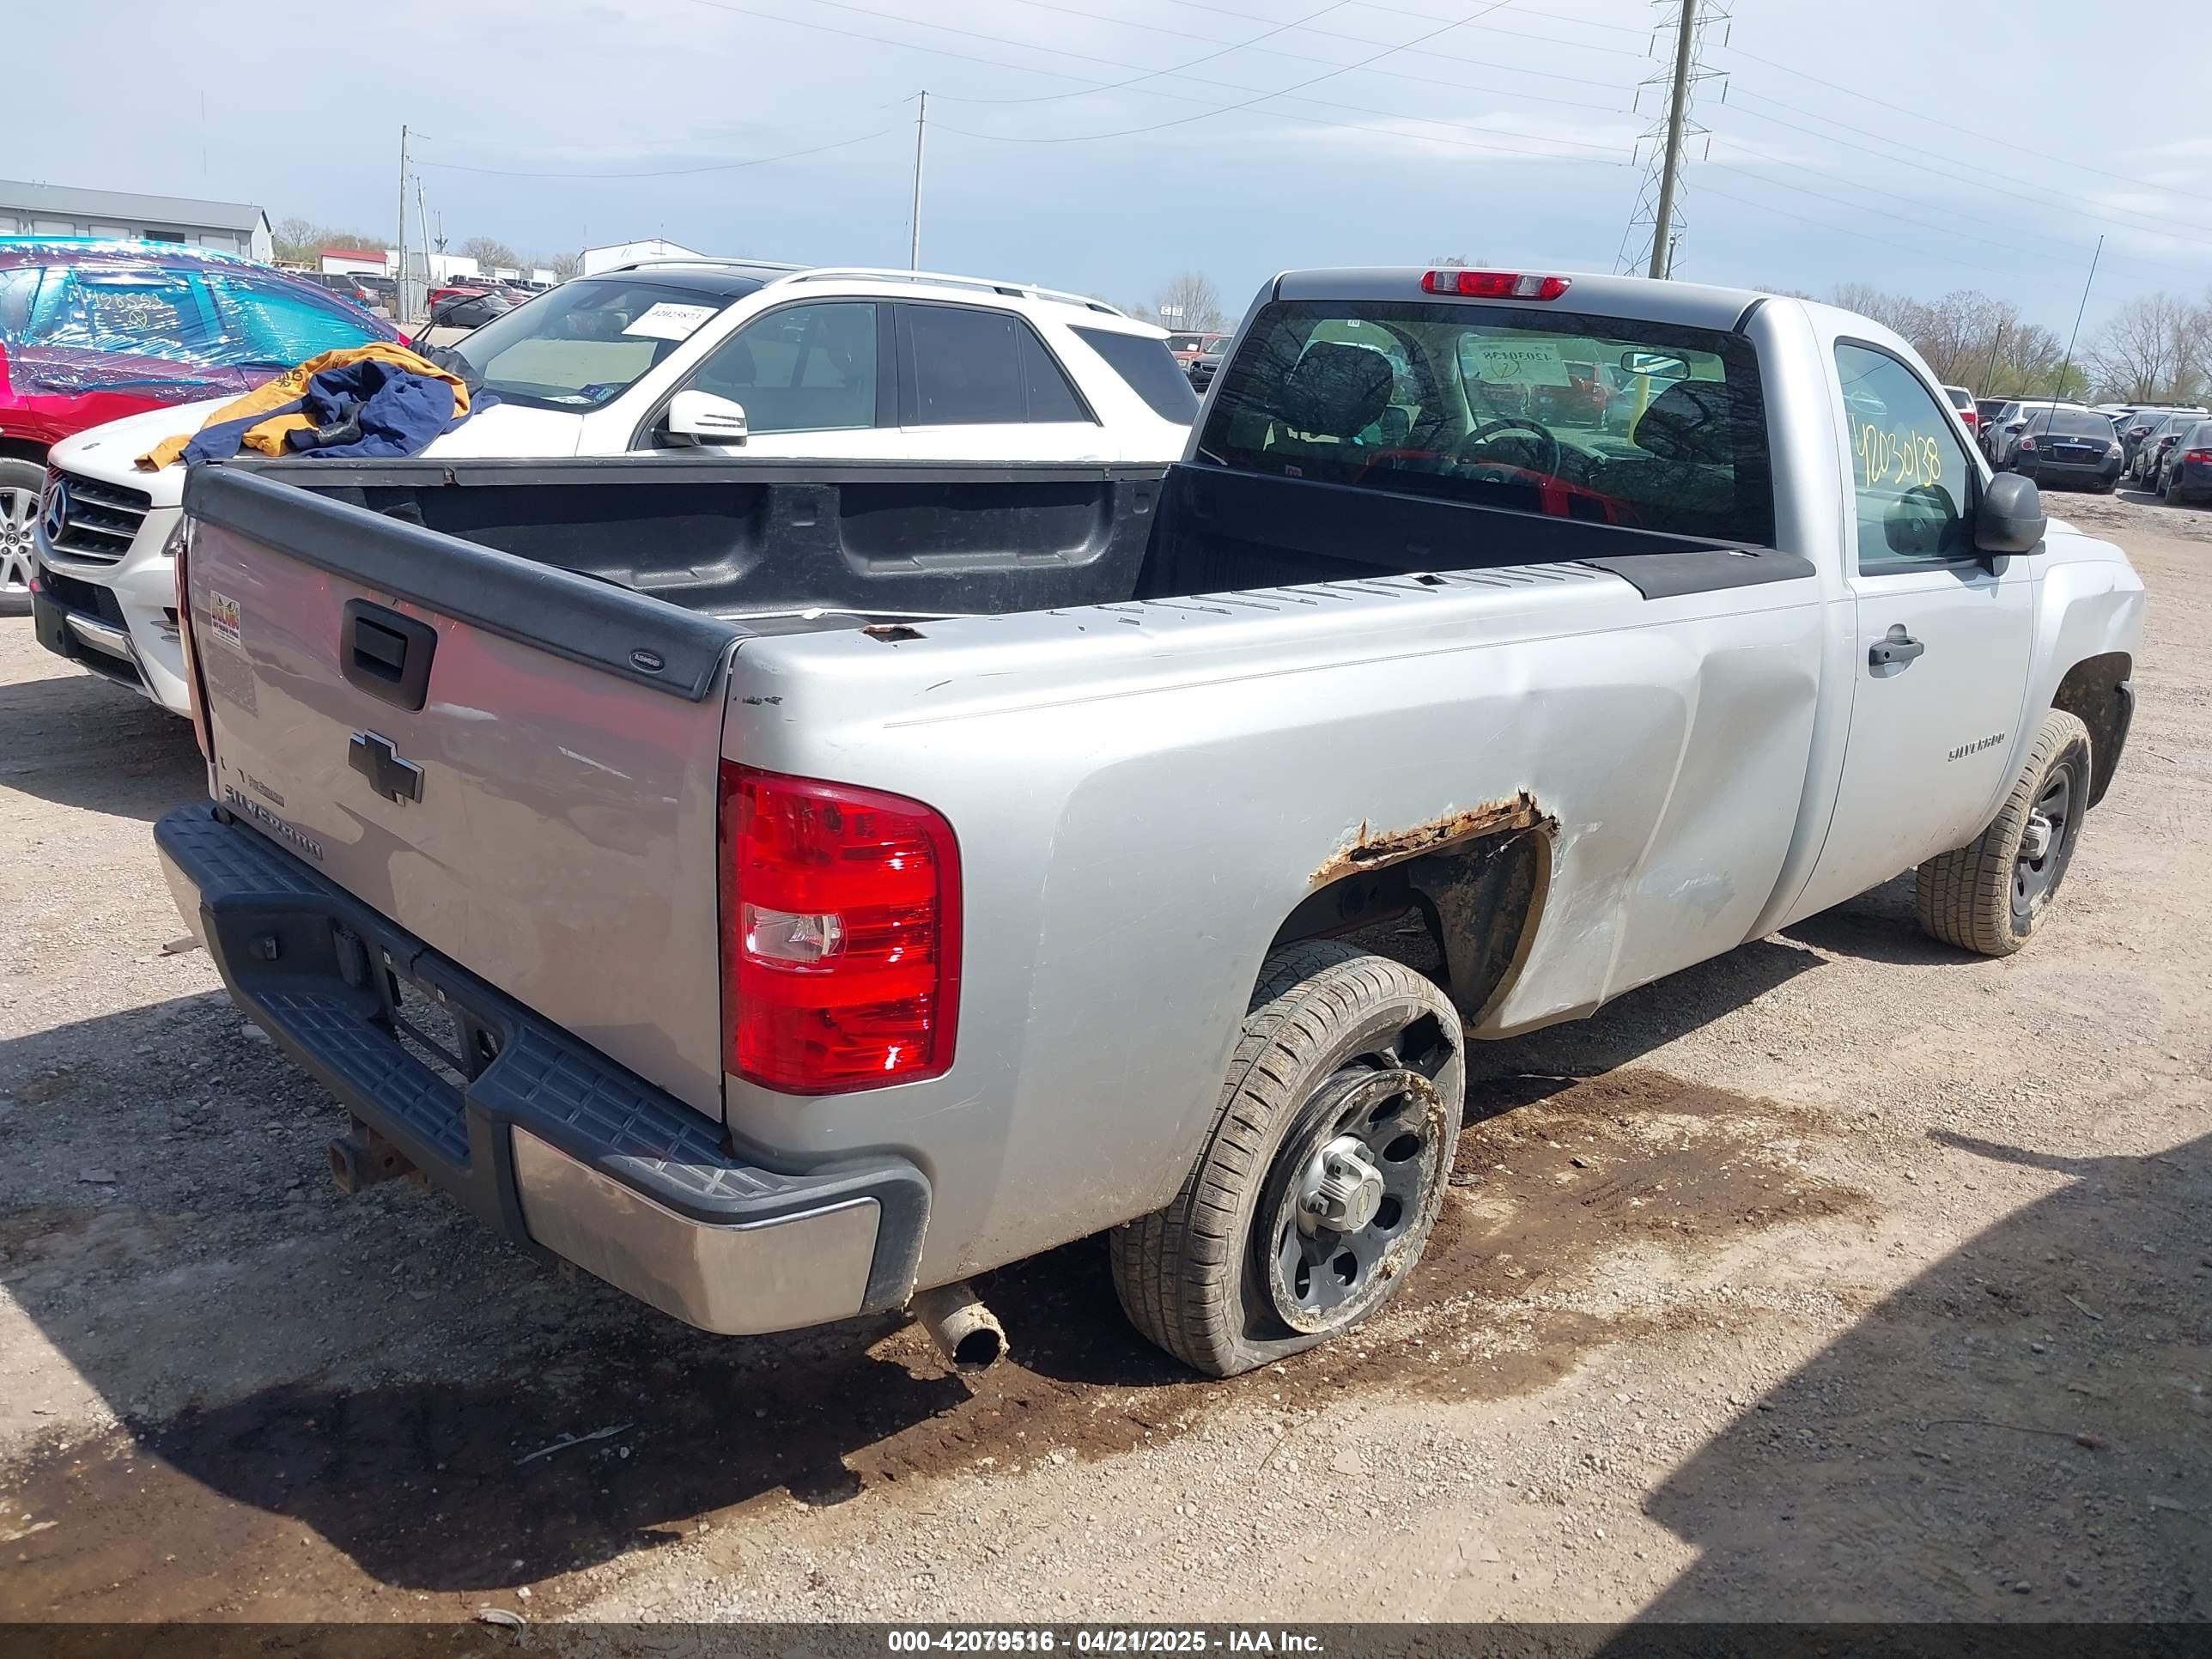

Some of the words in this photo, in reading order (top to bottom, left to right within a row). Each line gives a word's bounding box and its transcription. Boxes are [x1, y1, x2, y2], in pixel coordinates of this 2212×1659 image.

[1851, 415, 1942, 489] 42030138
[1947, 732, 2005, 763] SILVERADO
[224, 783, 324, 861] SILVERADO
